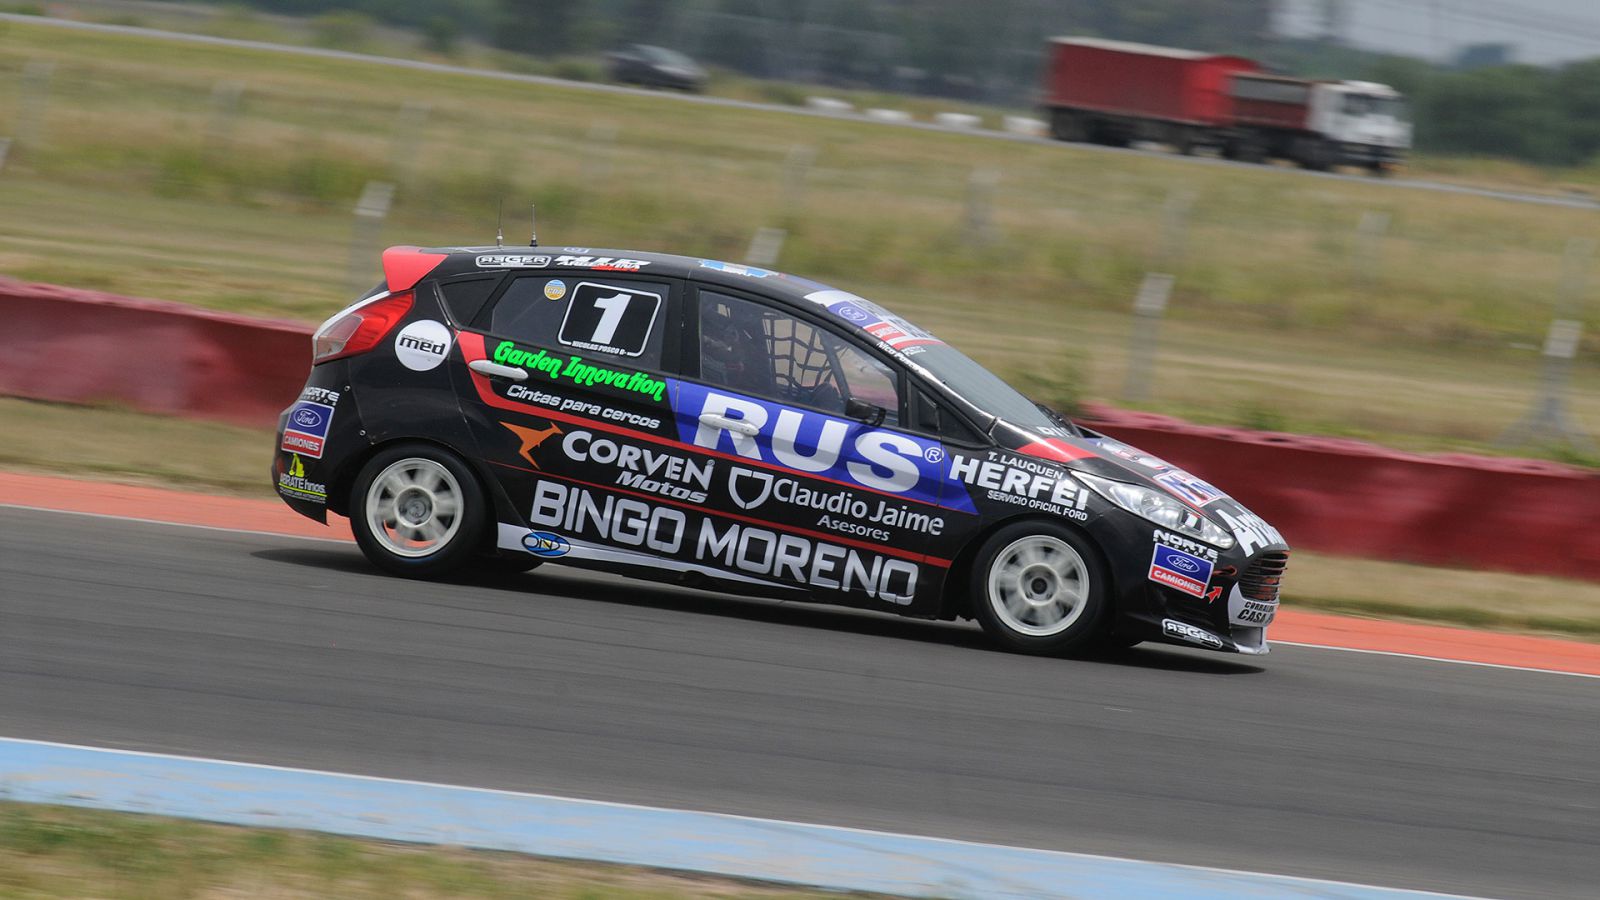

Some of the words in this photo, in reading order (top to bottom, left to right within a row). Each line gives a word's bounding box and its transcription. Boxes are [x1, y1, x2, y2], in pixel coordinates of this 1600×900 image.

[591, 293, 632, 345] 1
[399, 336, 446, 355] med
[494, 341, 563, 378] Garden
[562, 356, 666, 402] Innovation
[506, 384, 560, 405] Cintas
[560, 398, 602, 416] para
[602, 409, 661, 429] cercos
[562, 430, 714, 491] CORVEN
[1000, 454, 1064, 480] LAUQUEN
[615, 471, 709, 503] Motos
[949, 454, 1090, 511] HERFEI
[773, 478, 868, 518] Claudio
[869, 501, 945, 536] Jaime
[987, 490, 1028, 507] SERVICIO
[1028, 499, 1062, 515] OFICIAL
[1063, 507, 1089, 522] FORD
[530, 479, 686, 554] BINGO
[696, 517, 919, 606] MORENO
[817, 515, 891, 541] Asesores
[1153, 529, 1219, 559] NORTE
[1173, 557, 1195, 570] Ford
[1153, 570, 1203, 593] CAMIONES
